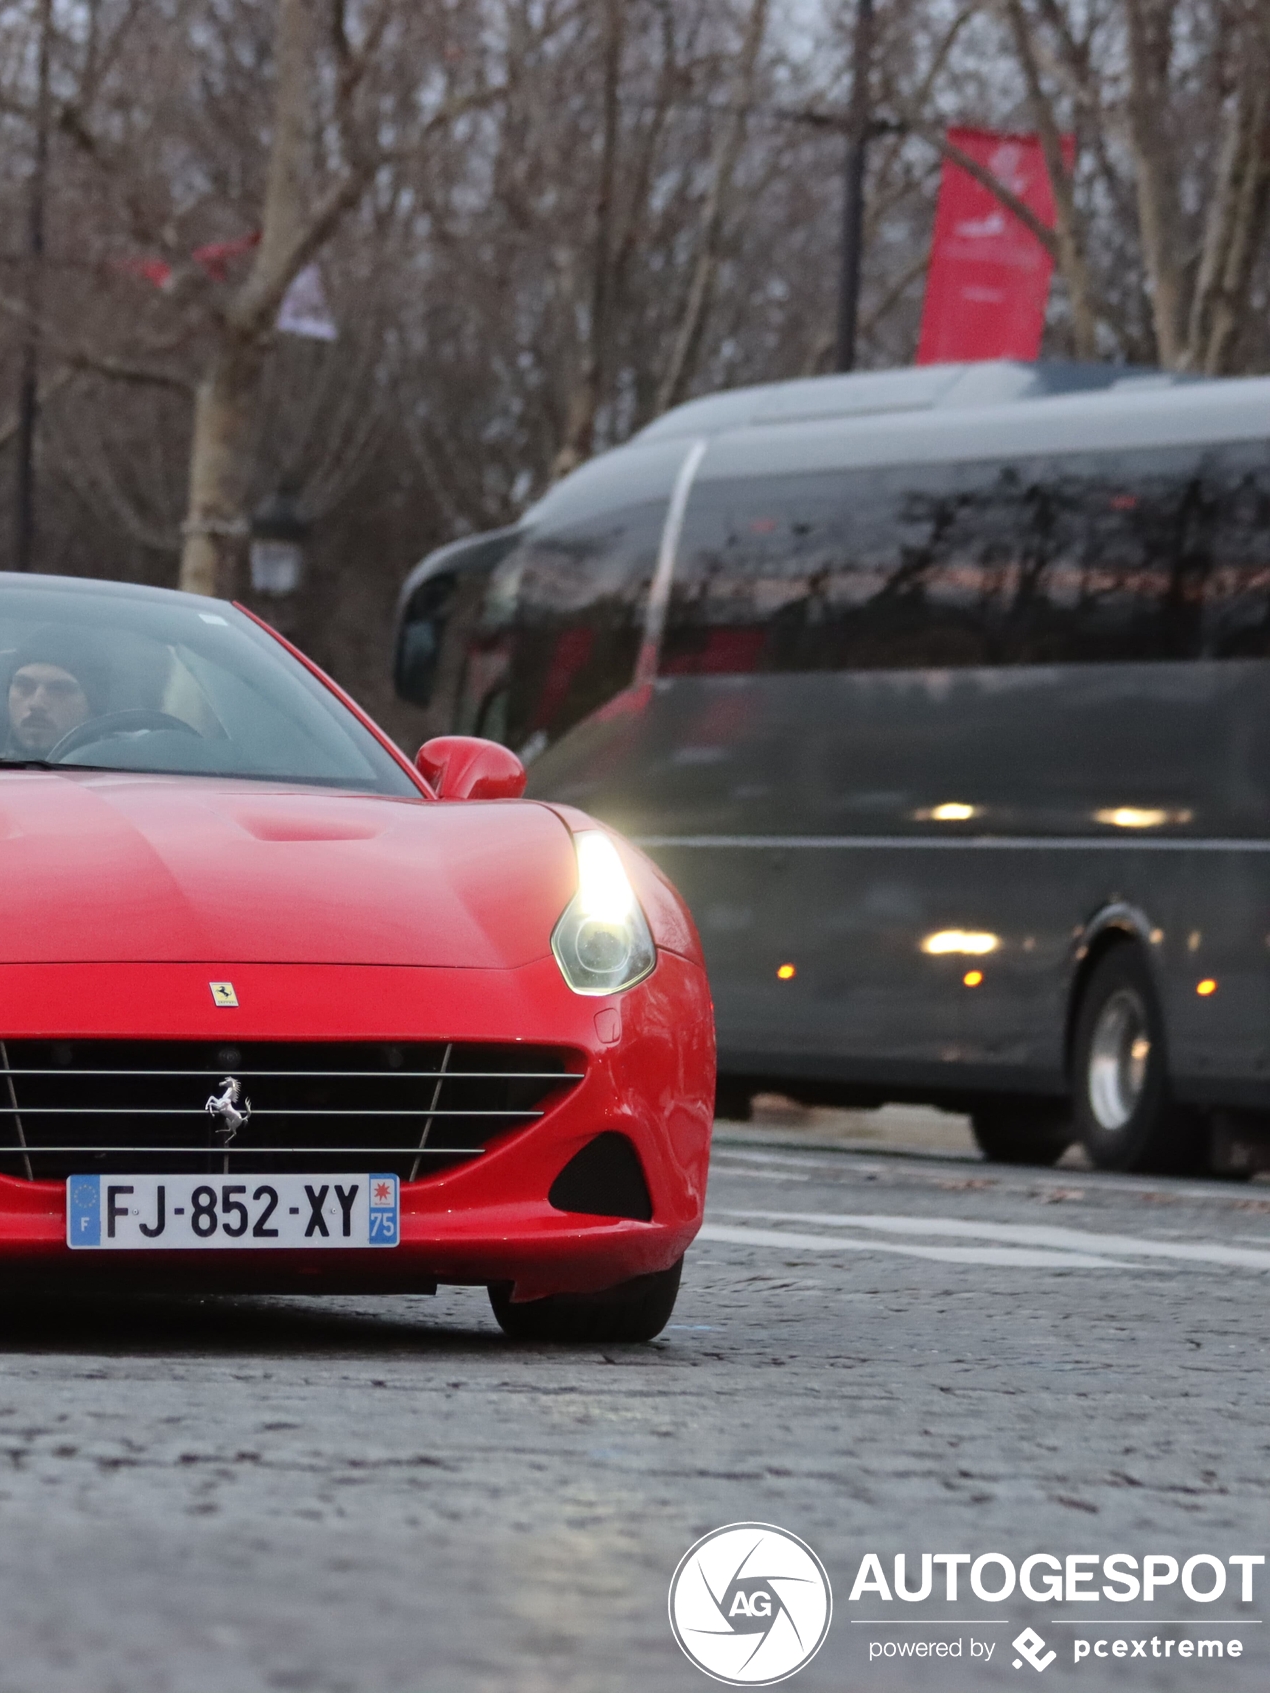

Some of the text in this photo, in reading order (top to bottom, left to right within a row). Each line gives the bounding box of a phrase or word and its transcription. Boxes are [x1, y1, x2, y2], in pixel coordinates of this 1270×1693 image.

[107, 1184, 359, 1239] FJ-852-XY
[80, 1217, 90, 1232] F
[371, 1212, 395, 1237] 75
